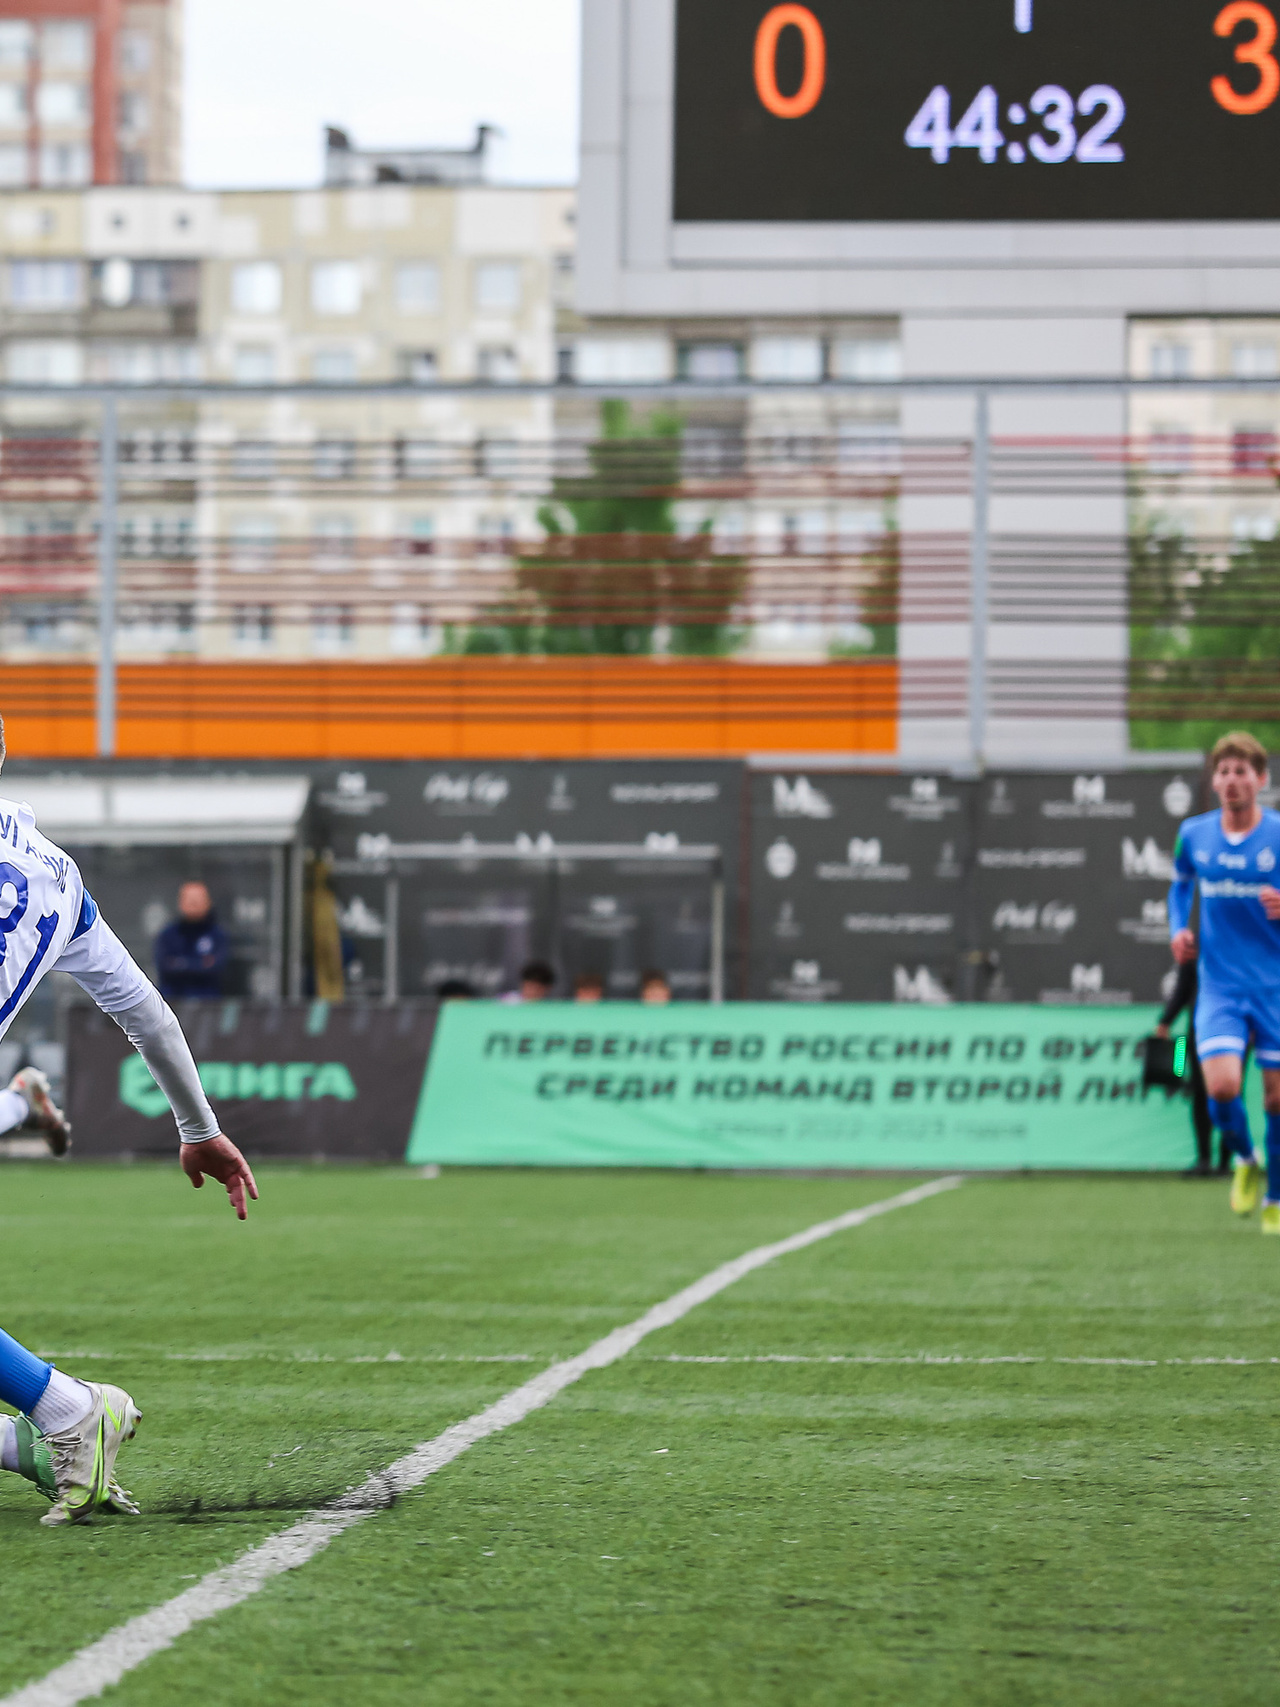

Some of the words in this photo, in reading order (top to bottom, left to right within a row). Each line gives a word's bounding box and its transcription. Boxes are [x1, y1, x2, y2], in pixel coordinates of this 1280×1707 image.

[754, 3, 826, 119] 0
[1211, 0, 1280, 115] 3
[904, 85, 1125, 164] 44:32
[483, 1031, 766, 1061] ПЕРВЕНСТВО
[780, 1032, 952, 1063] РОССИИ
[967, 1034, 1027, 1063] ПО
[534, 1071, 677, 1106] СРЕДИ
[692, 1072, 875, 1106] КОМАНД
[890, 1066, 1063, 1104] ВТОРОЙ
